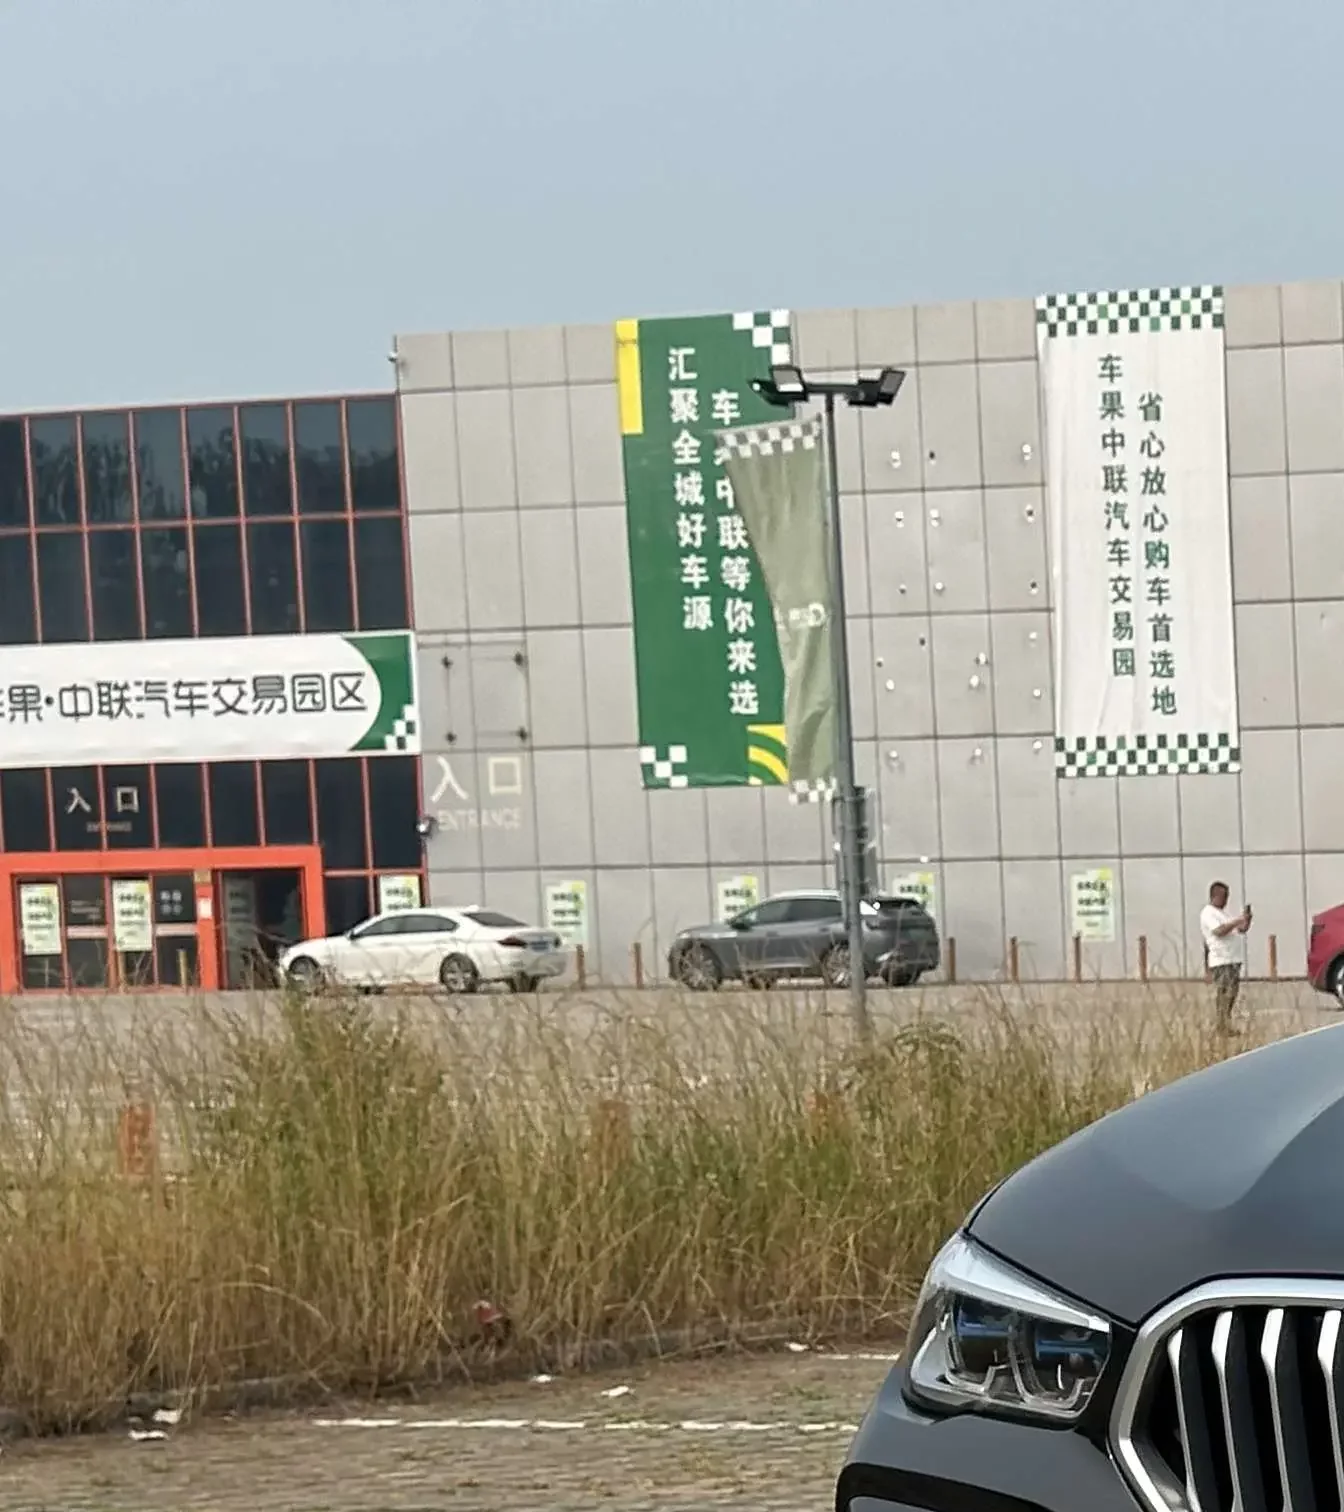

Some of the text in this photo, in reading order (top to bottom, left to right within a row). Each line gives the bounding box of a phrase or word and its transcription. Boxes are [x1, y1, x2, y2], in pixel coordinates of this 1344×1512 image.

[667, 347, 714, 632] 汇聚全城好车源
[1097, 353, 1136, 678] 车果中联汽车交易园
[1138, 392, 1178, 717] 省心放心购车首选地
[0, 671, 367, 723] 果·中联汽车交易园区
[431, 756, 521, 803] 入口
[66, 787, 139, 813] 入口
